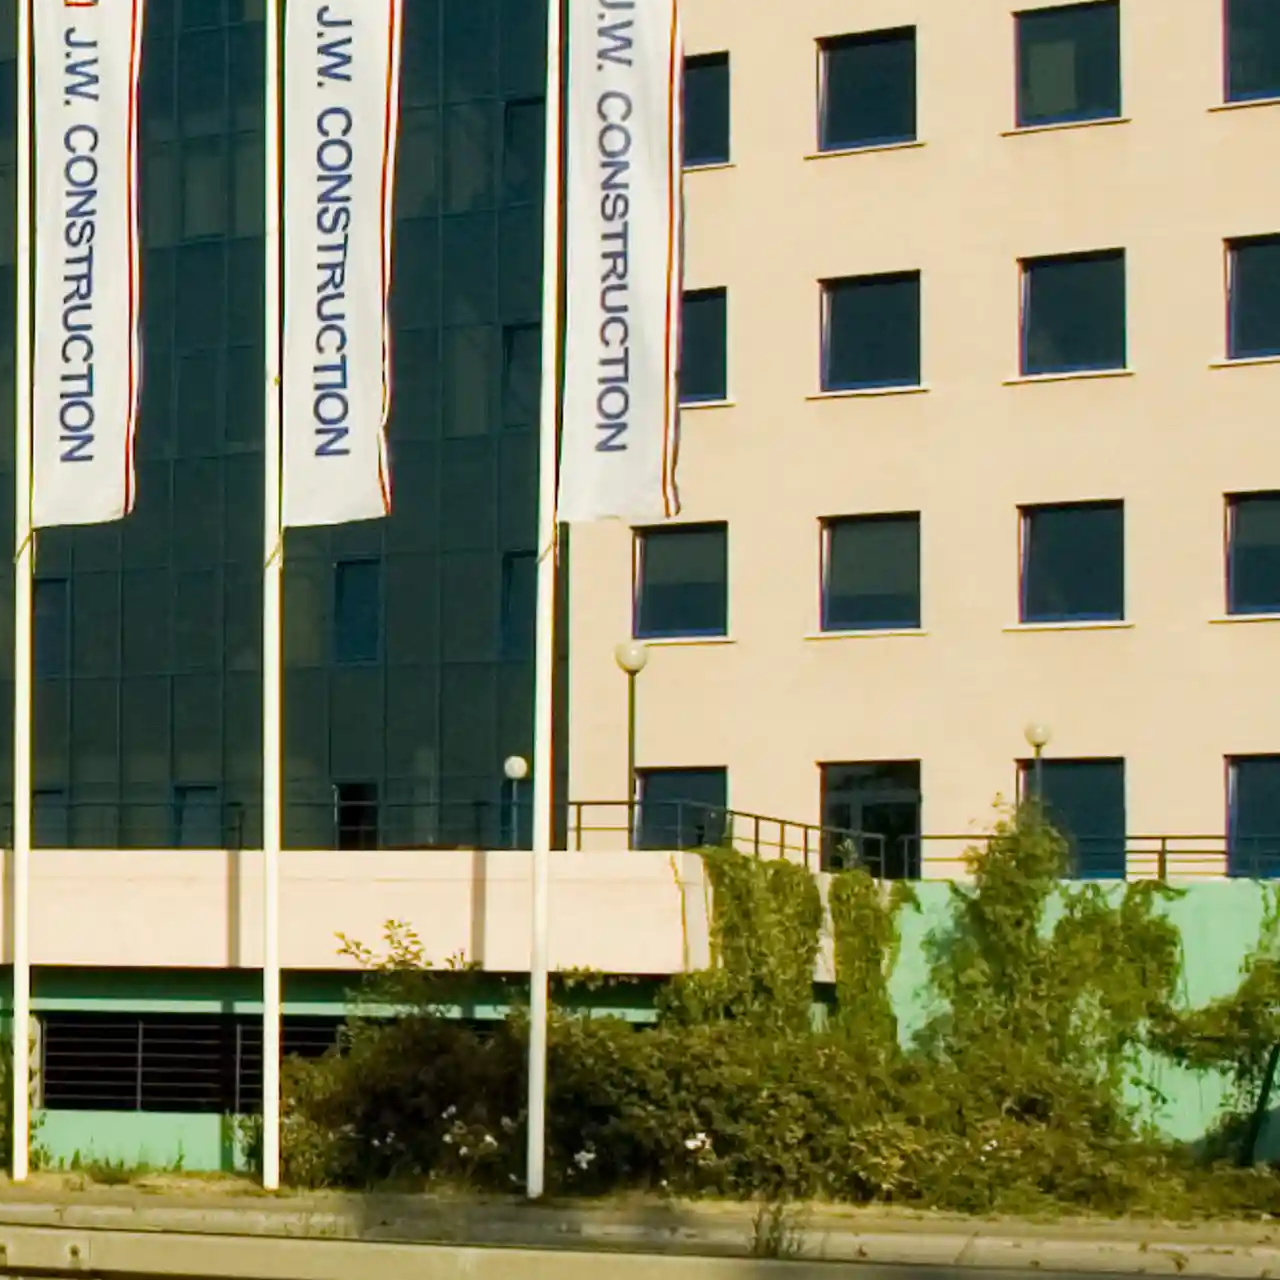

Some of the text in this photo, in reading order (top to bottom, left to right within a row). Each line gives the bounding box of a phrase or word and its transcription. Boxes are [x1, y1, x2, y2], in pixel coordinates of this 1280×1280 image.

[58, 26, 101, 463] J.W. CONSTRUCTION
[312, 4, 354, 457] J.W. CONSTRUCTION
[594, 90, 633, 453] CONSTRUCTION
